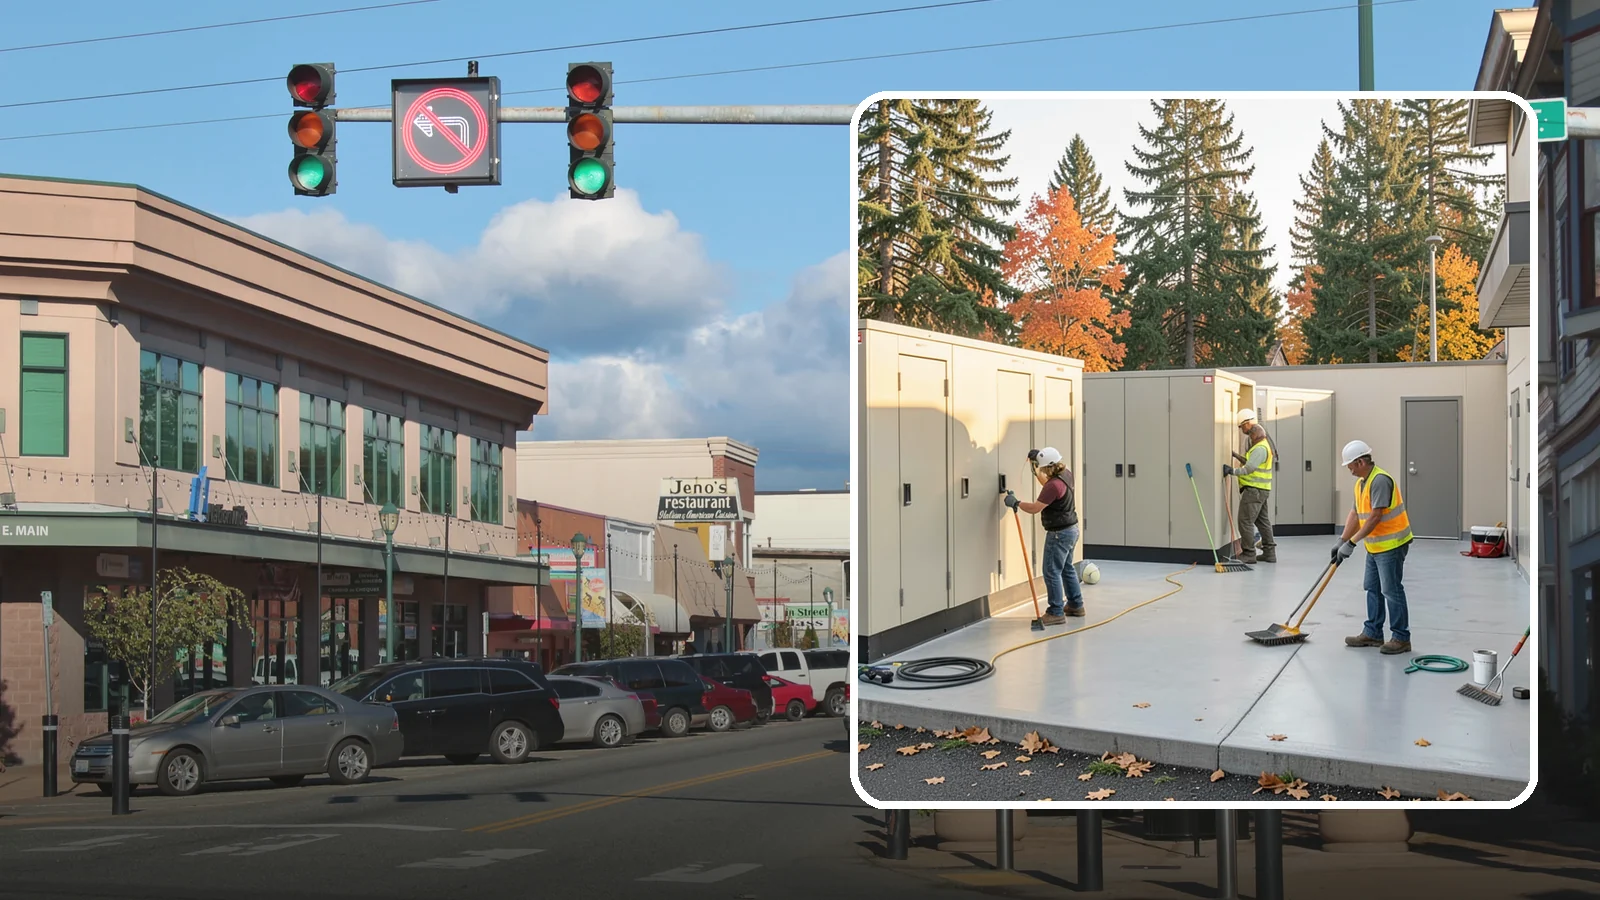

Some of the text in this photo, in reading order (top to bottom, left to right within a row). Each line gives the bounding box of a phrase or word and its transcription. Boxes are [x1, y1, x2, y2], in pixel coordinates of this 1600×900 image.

[670, 480, 727, 495] Jeno's
[665, 496, 731, 509] restaurant
[686, 509, 714, 520] American
[715, 509, 738, 520] Cuisine
[2, 525, 49, 536] E. MAIN
[797, 607, 829, 617] Street
